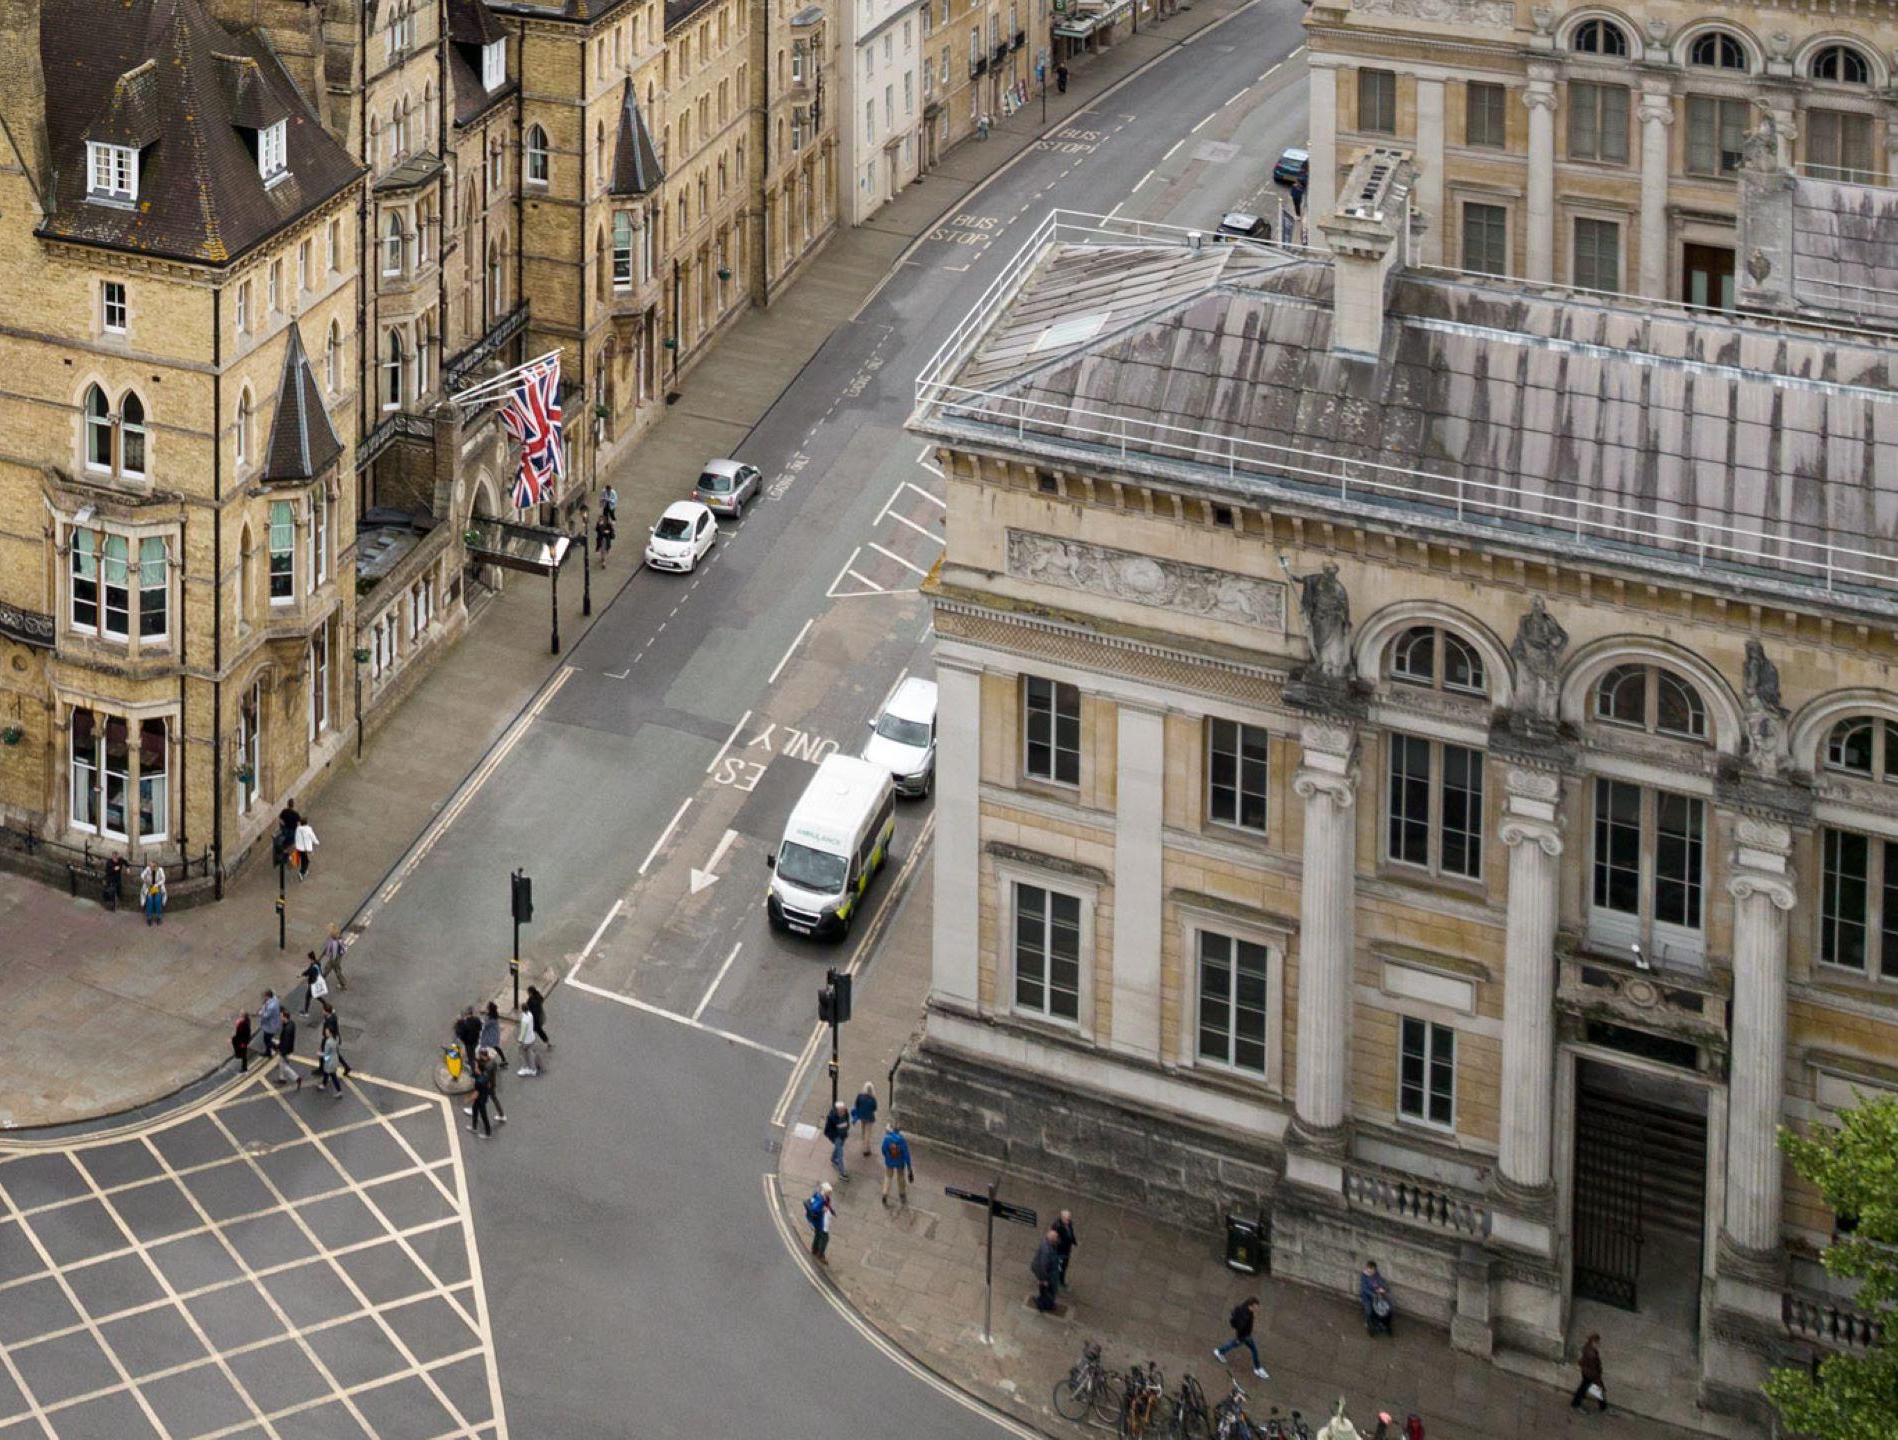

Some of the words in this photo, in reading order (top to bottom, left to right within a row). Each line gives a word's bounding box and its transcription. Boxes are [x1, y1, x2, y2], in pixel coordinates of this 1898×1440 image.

[1057, 128, 1101, 141] BUS
[1036, 140, 1093, 155] STOP
[952, 215, 998, 229] BUS
[930, 228, 990, 246] STOP
[747, 722, 840, 765] ONLY
